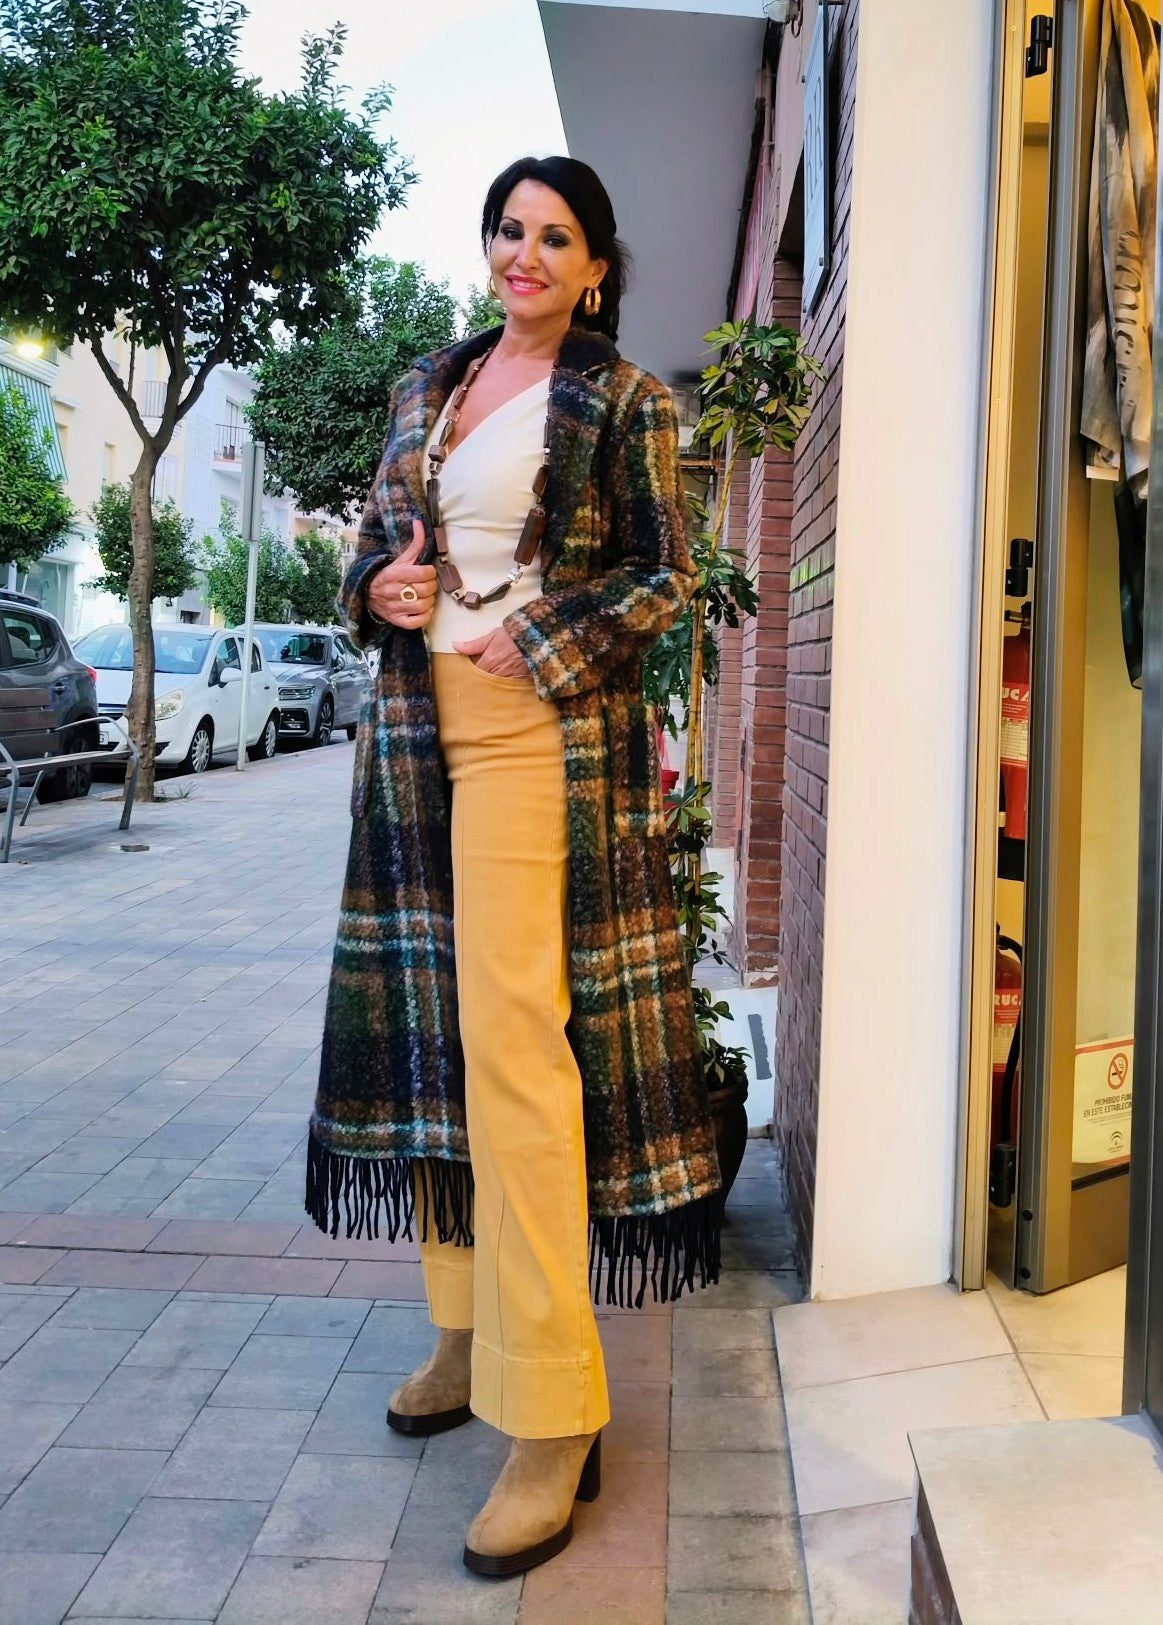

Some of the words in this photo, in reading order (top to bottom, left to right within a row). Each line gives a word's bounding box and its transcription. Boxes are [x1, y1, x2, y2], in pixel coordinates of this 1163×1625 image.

[994, 993, 1022, 1006] RUC
[1095, 1095, 1120, 1105] PROHIBIDO
[1091, 1107, 1103, 1115] ESTE
